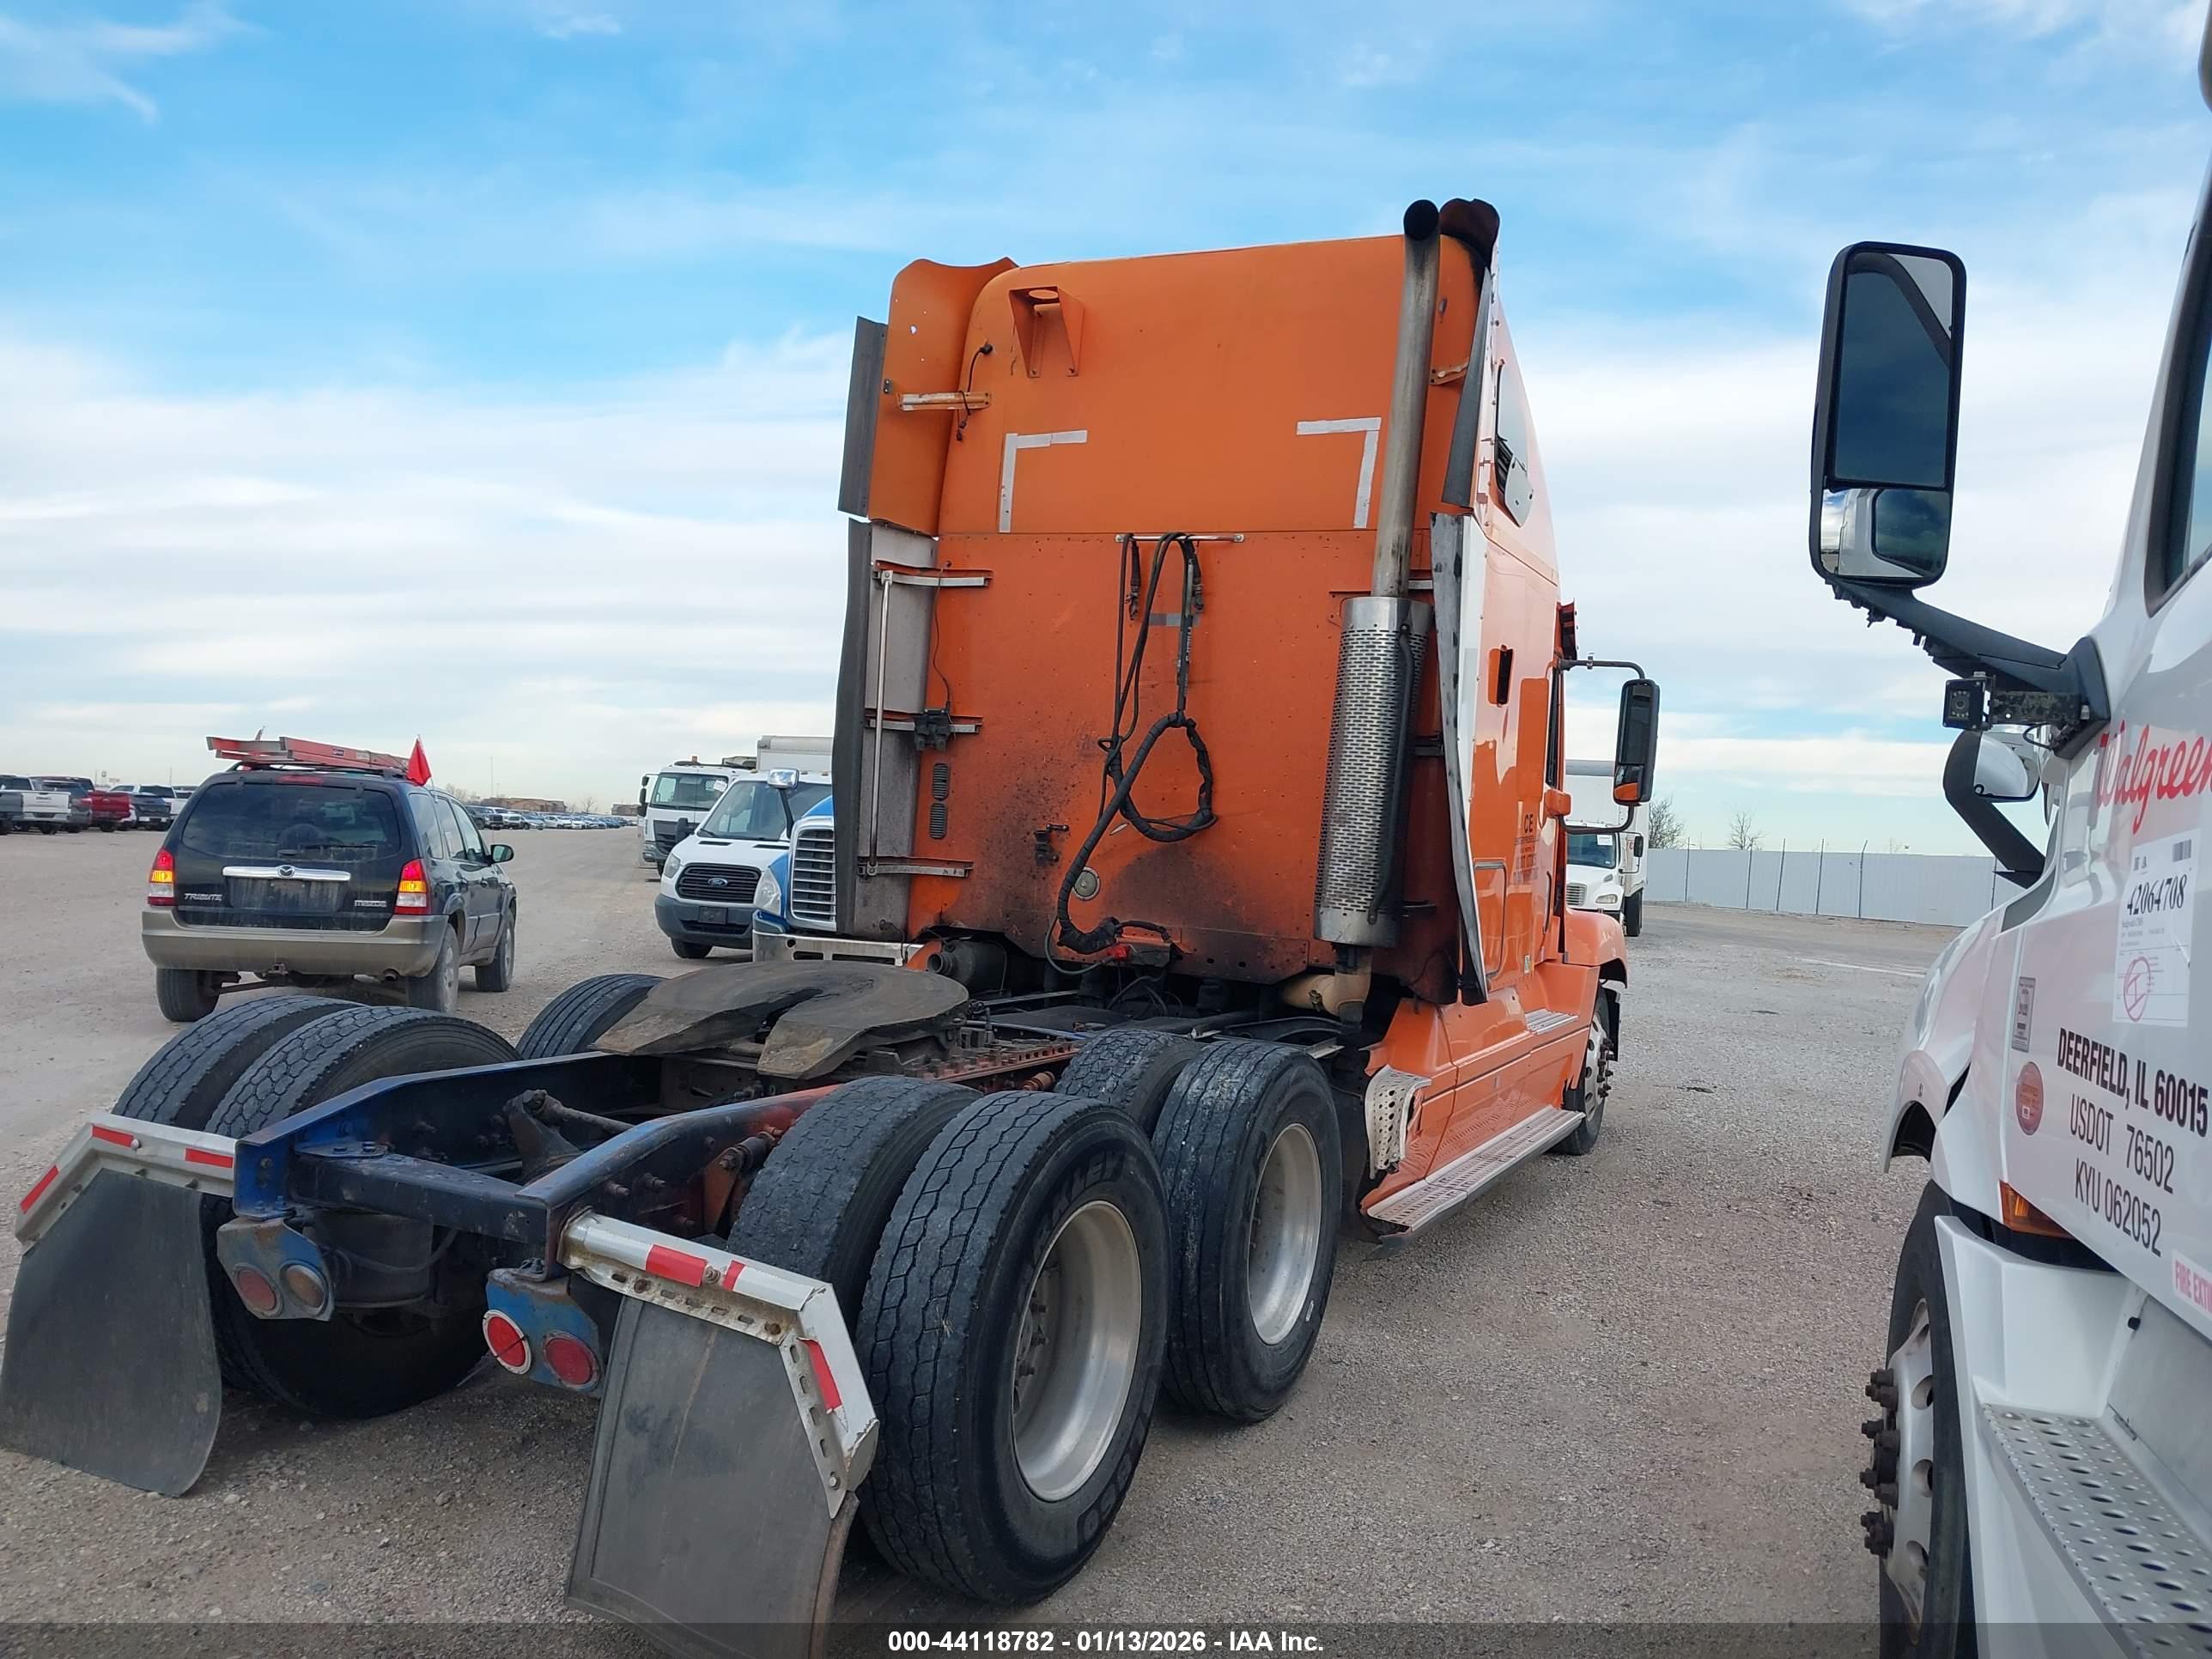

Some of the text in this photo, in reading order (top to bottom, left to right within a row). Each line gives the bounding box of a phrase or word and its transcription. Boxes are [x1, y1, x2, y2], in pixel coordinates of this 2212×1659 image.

[2127, 873, 2188, 915] 42064708
[2057, 1027, 2209, 1138] DEERFIELD, IL 60015
[2070, 1093, 2174, 1194] USDOT 76502
[2075, 1158, 2161, 1257] KYU 062052
